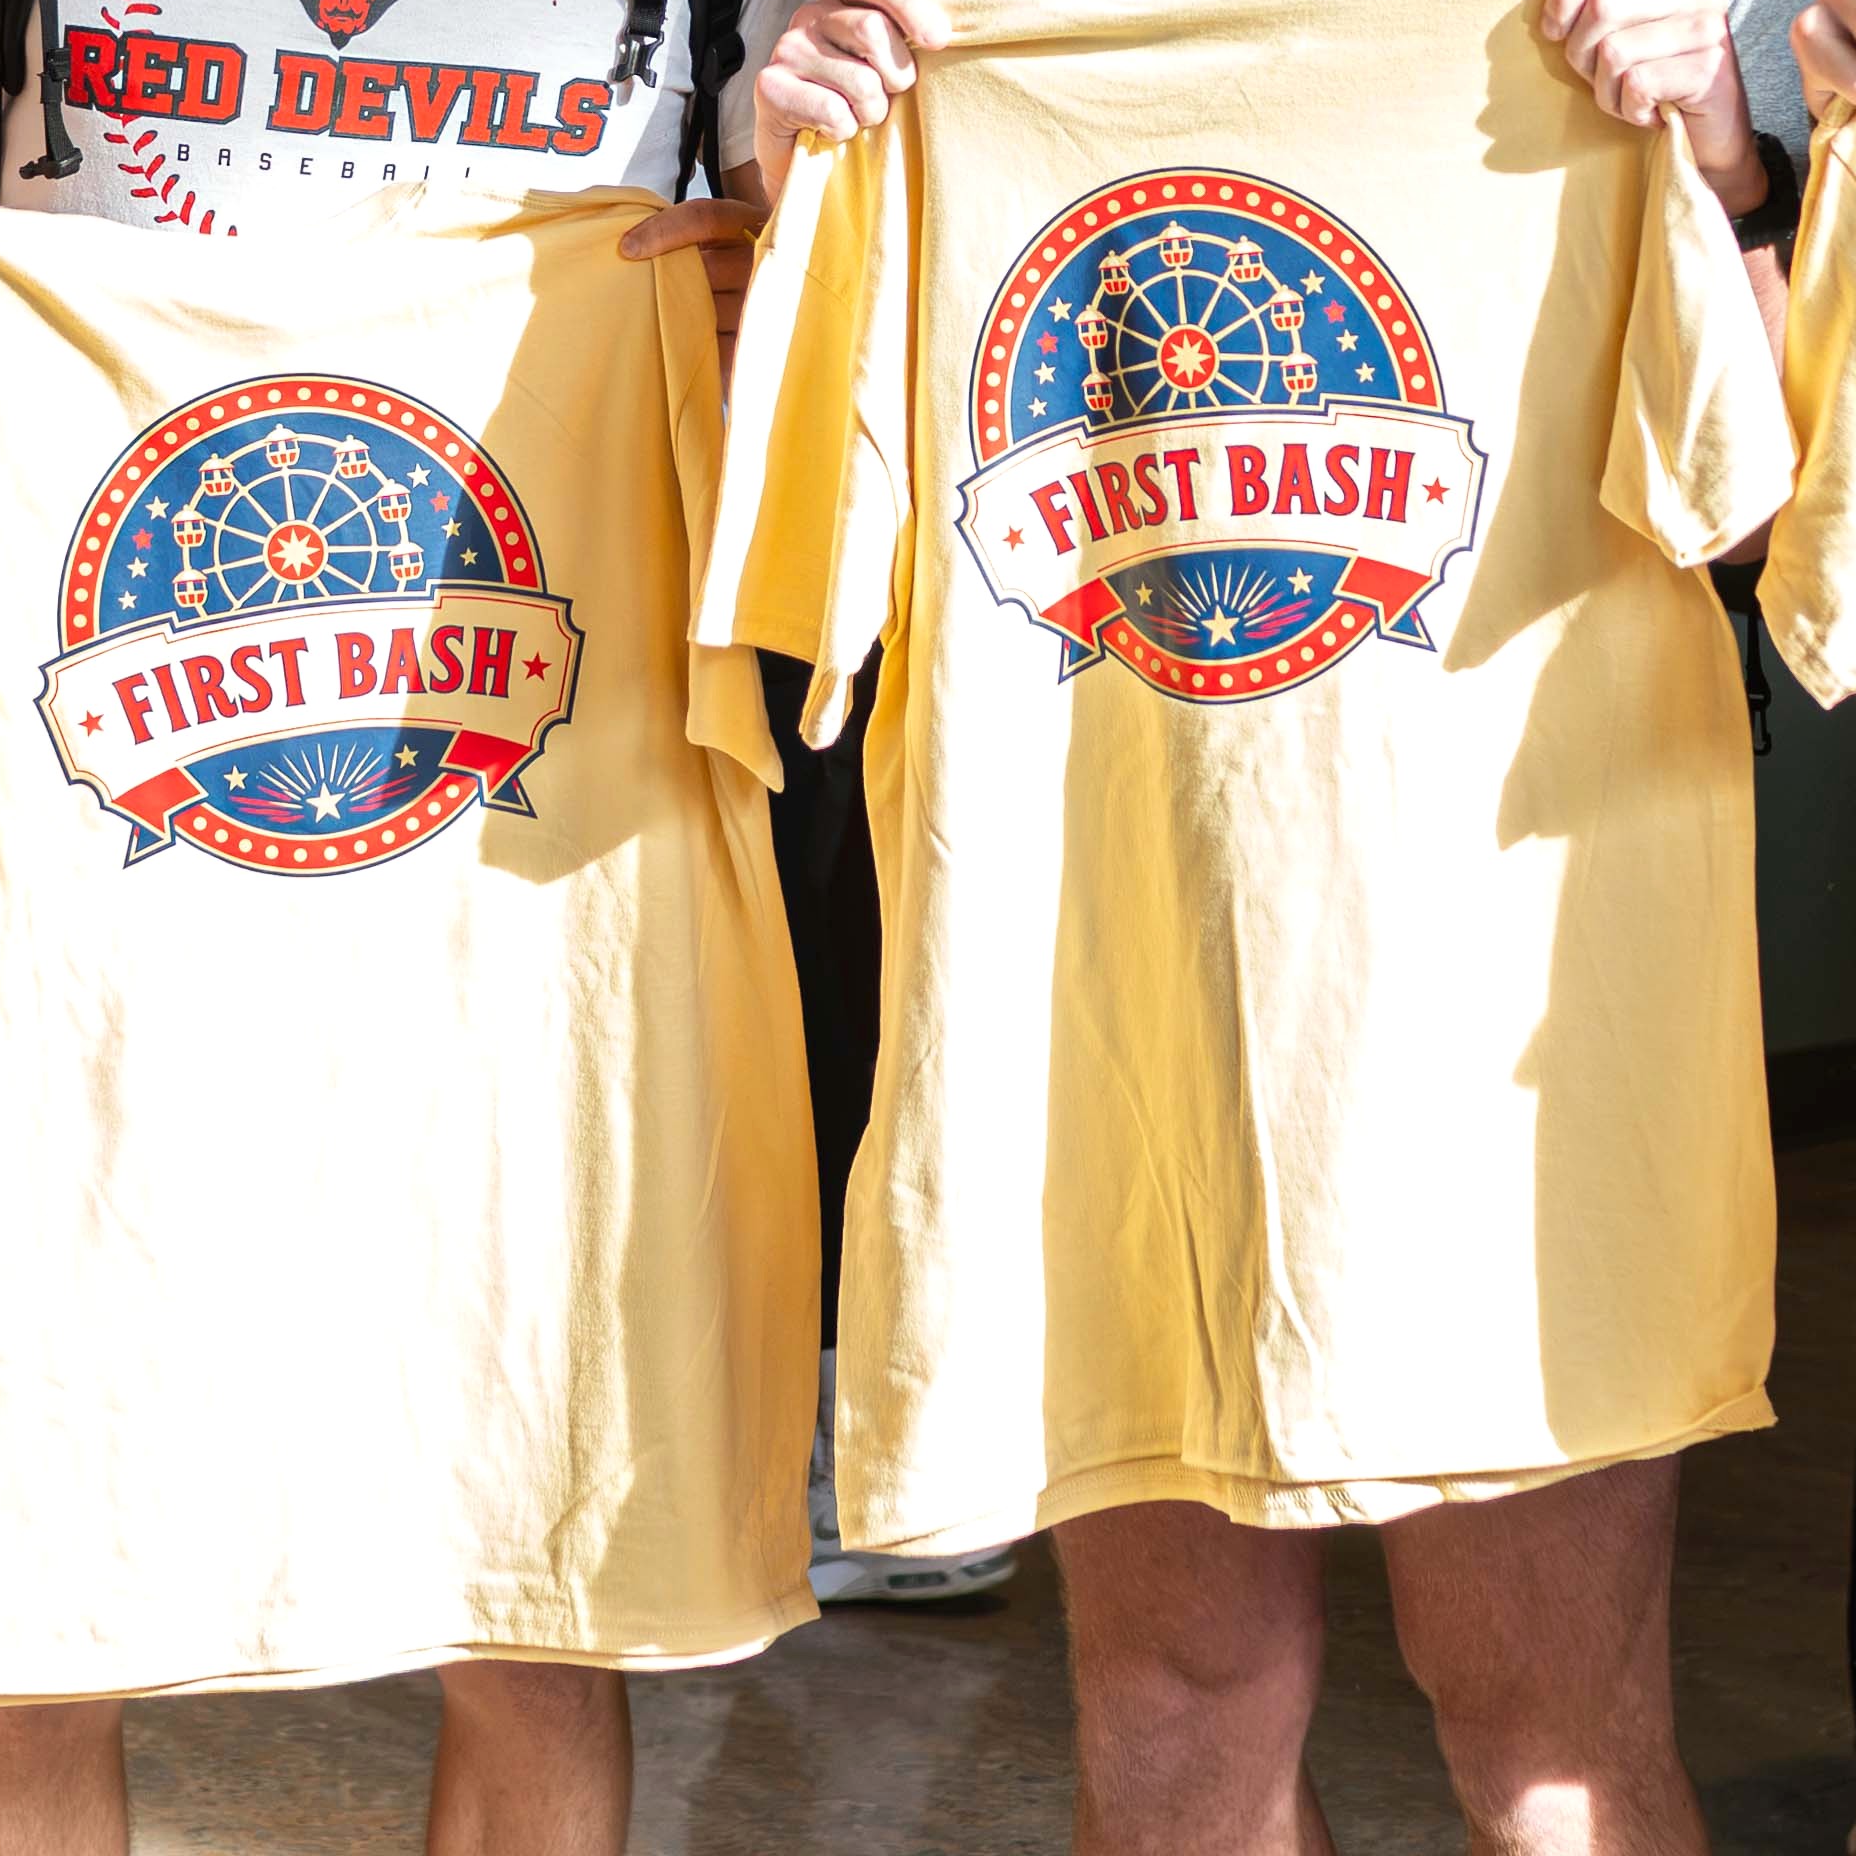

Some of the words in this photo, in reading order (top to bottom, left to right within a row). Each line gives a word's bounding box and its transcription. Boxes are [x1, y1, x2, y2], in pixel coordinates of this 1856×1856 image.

[64, 25, 248, 125] RED
[266, 48, 614, 157] DEVILS
[1028, 448, 1201, 556] FIRST
[1224, 443, 1416, 524] BASH
[112, 637, 309, 746] FIRST
[334, 626, 518, 700] BASH
